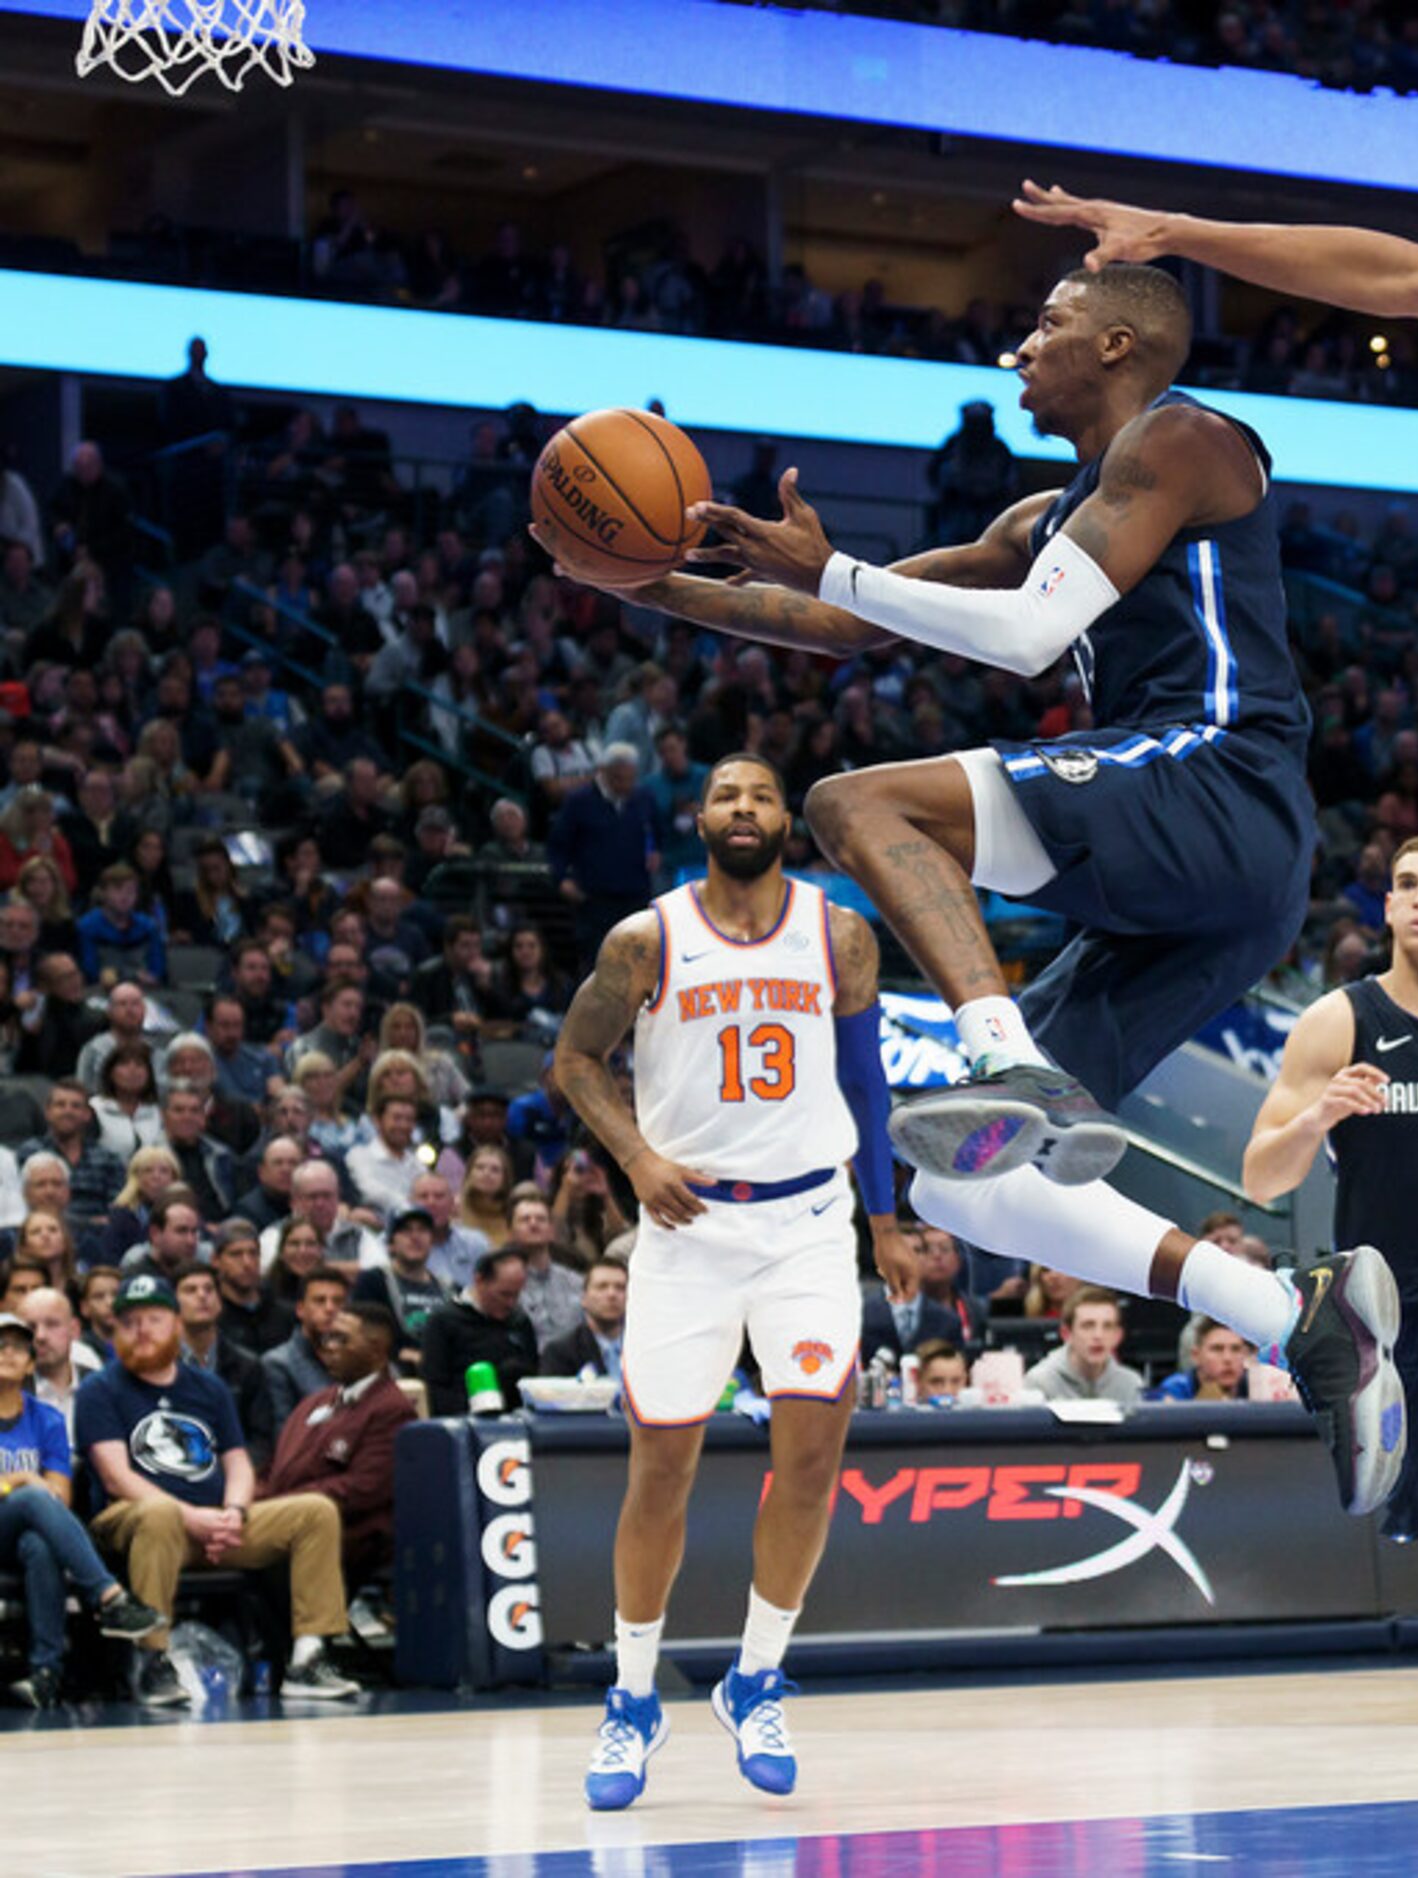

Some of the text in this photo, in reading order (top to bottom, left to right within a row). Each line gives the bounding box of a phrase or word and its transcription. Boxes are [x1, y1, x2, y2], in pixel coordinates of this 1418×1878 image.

[677, 977, 822, 1022] NEW YORK
[717, 1022, 796, 1102] 13
[477, 1439, 532, 1506] G
[481, 1513, 537, 1579] G
[760, 1456, 1214, 1604] YPERX
[487, 1583, 543, 1650] G
